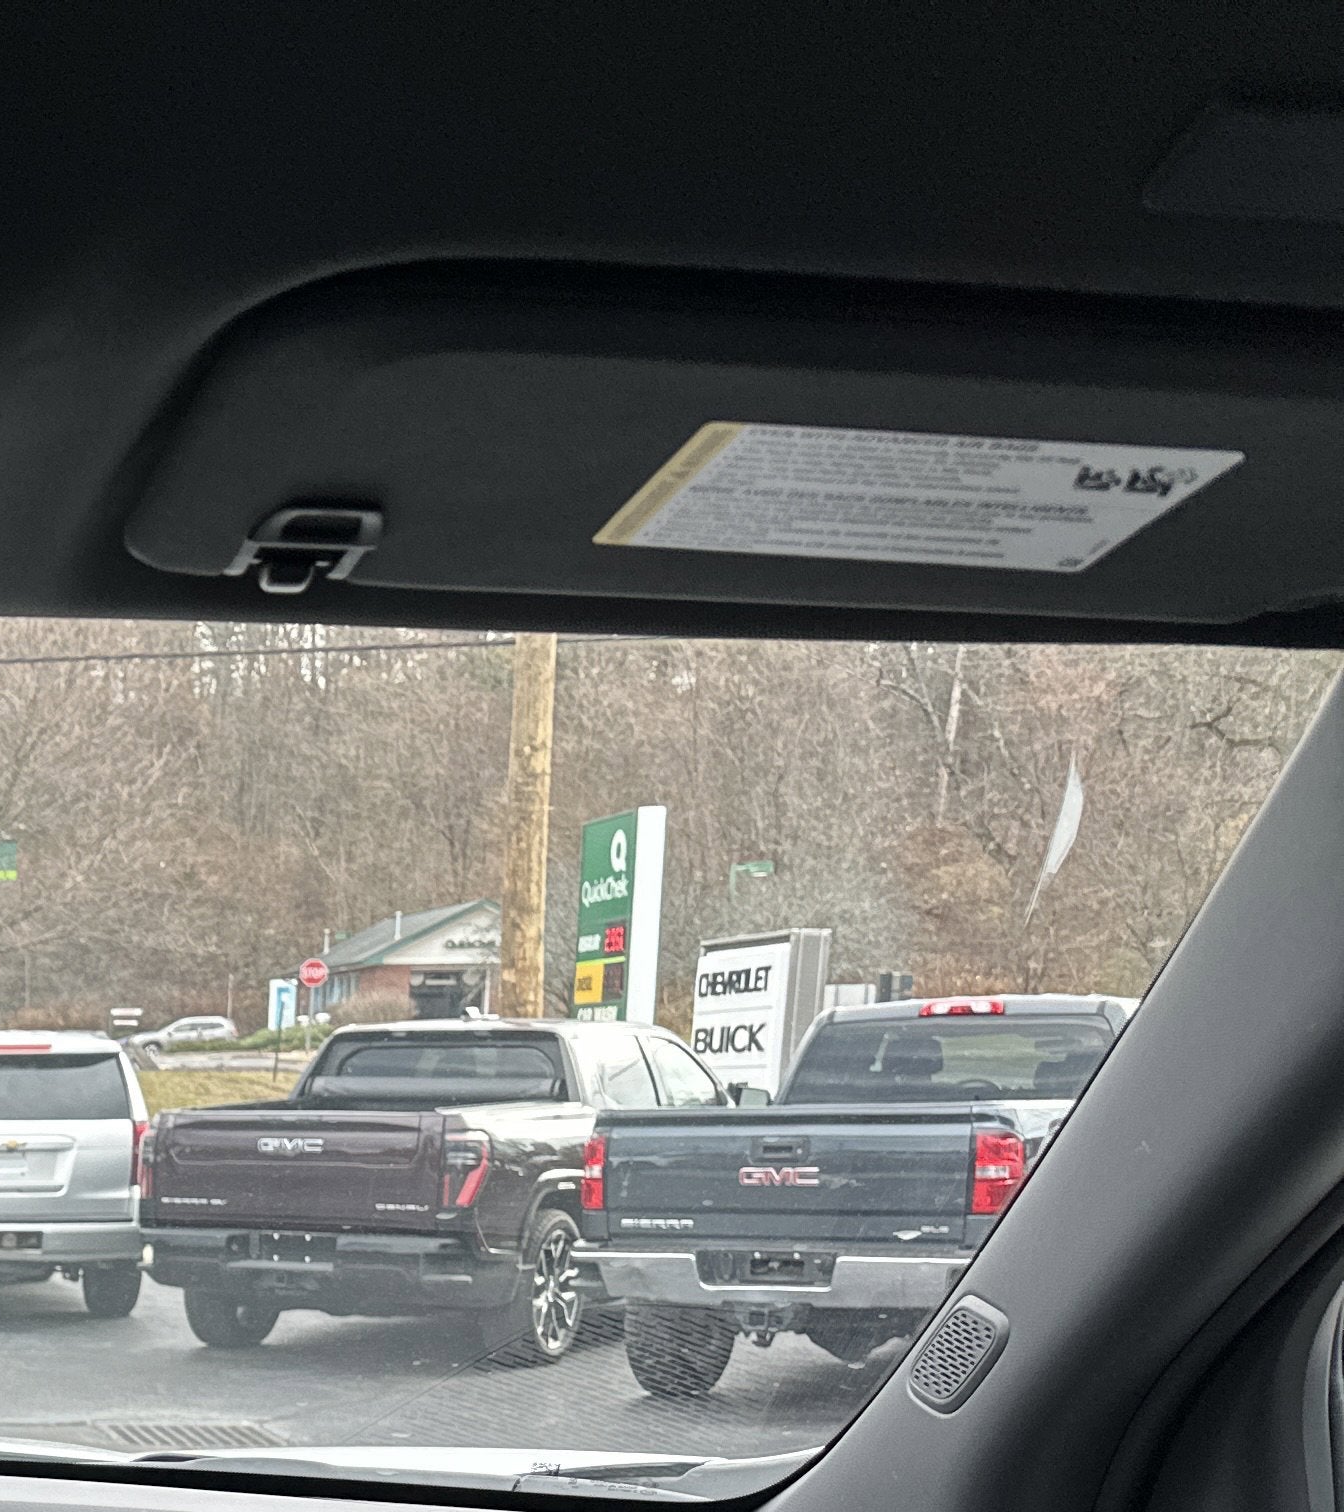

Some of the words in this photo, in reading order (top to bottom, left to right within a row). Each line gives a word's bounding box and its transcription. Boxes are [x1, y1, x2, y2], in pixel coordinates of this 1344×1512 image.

[302, 966, 326, 980] STOP
[699, 965, 772, 998] CHEVROLET
[694, 1022, 767, 1053] BUICK
[257, 1137, 325, 1153] GMC
[738, 1166, 821, 1186] GMC
